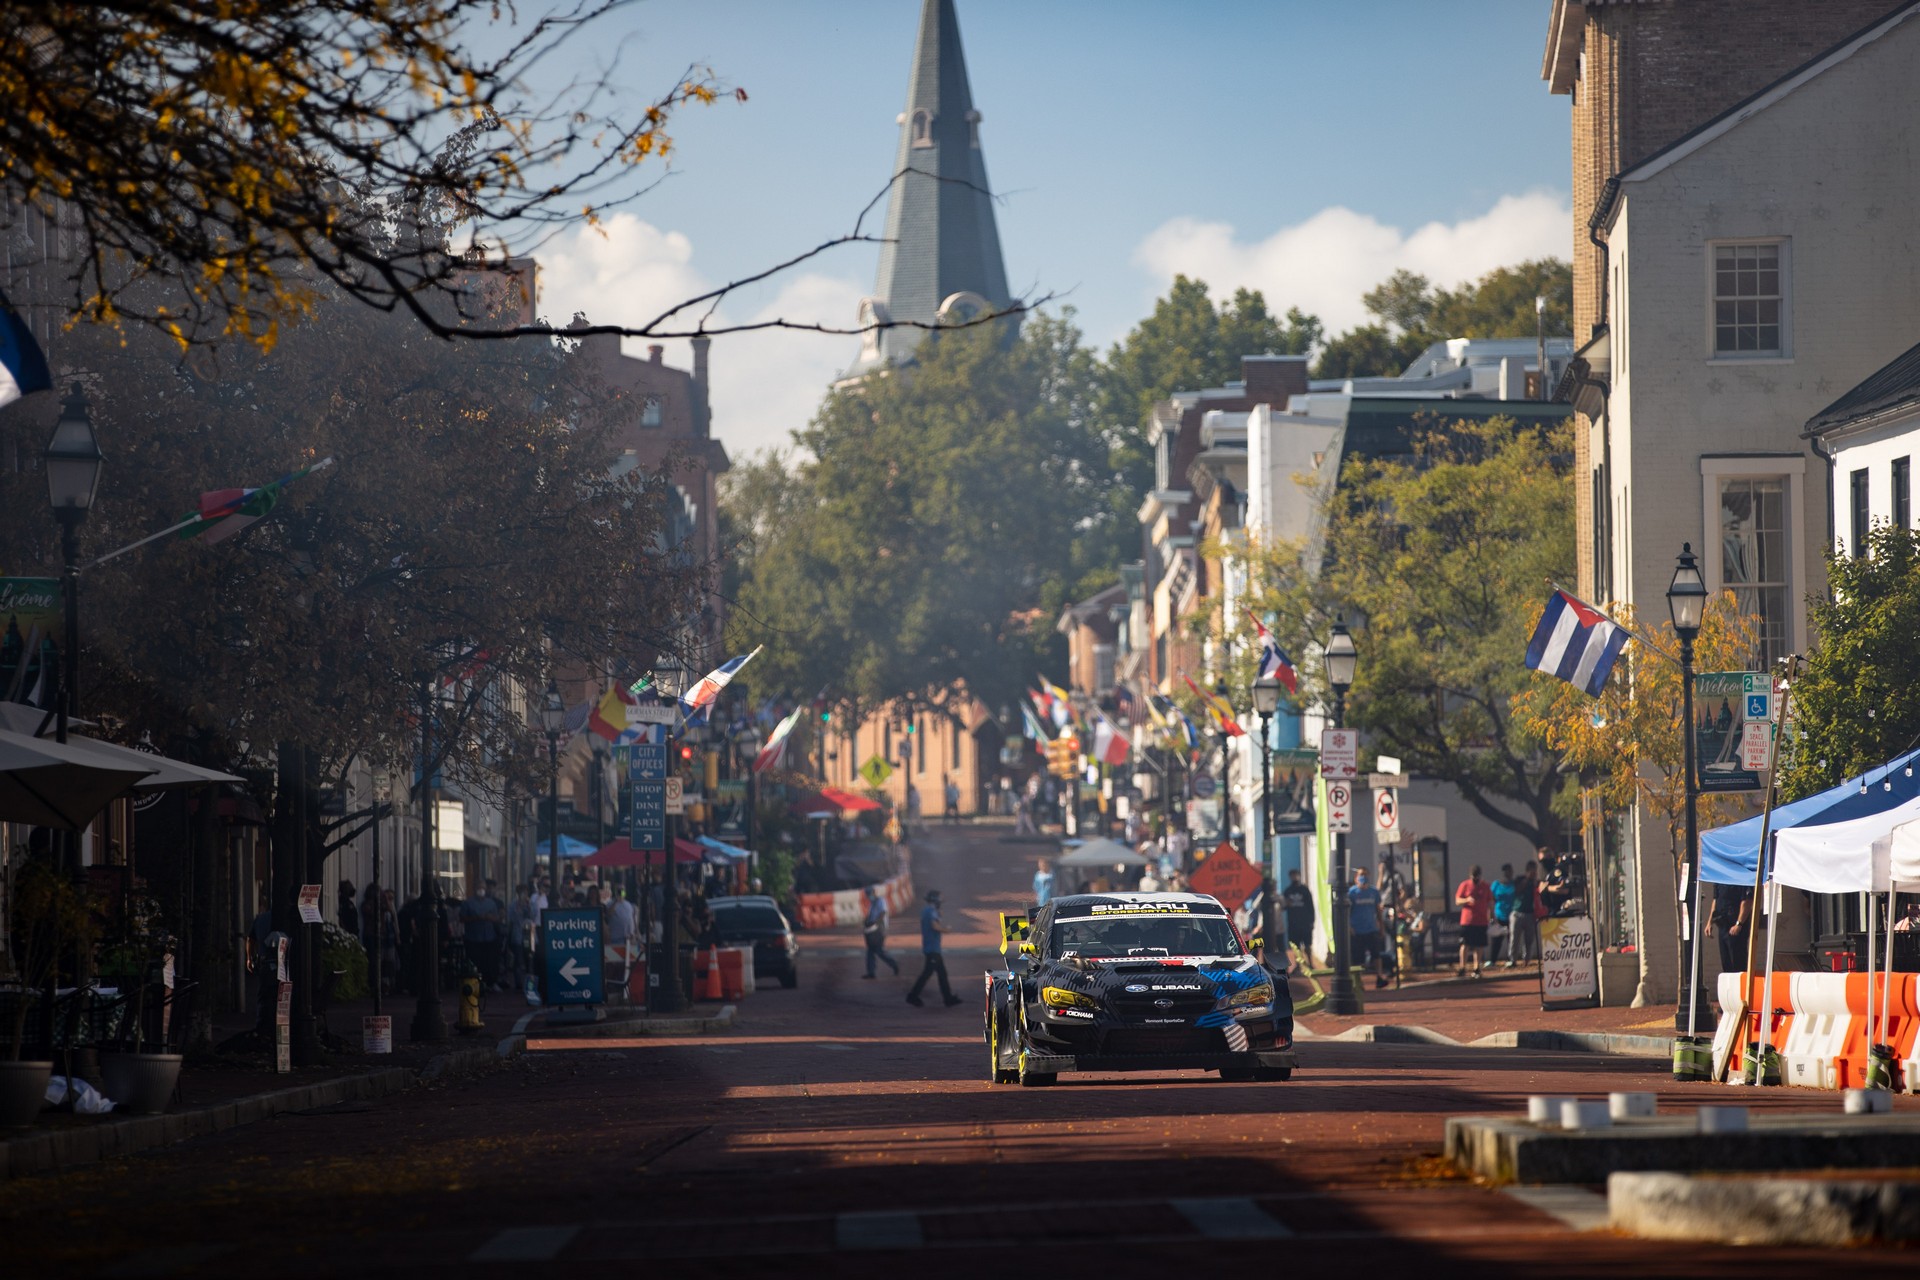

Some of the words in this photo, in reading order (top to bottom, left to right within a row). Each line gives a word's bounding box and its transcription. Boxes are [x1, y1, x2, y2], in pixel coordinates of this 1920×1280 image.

[0, 583, 54, 611] lcome
[1699, 676, 1743, 693] Welcom
[1745, 678, 1752, 690] 2
[652, 707, 674, 717] STREET
[638, 747, 656, 757] CITY
[632, 759, 664, 769] OFFICES
[635, 785, 662, 793] SHOP
[636, 801, 660, 809] DINE
[635, 818, 660, 826] ARTS
[1211, 860, 1242, 872] LANES
[1214, 874, 1240, 886] SHIFT
[1091, 903, 1188, 911] SUBARU
[548, 918, 597, 932] Parking
[552, 939, 565, 950] to
[568, 937, 595, 949] Left
[1561, 933, 1591, 949] STOP
[1544, 948, 1591, 962] SQUINTING
[1547, 968, 1574, 989] 75%
[1574, 972, 1589, 981] OFF
[1065, 1010, 1094, 1019] YOKOHAMA
